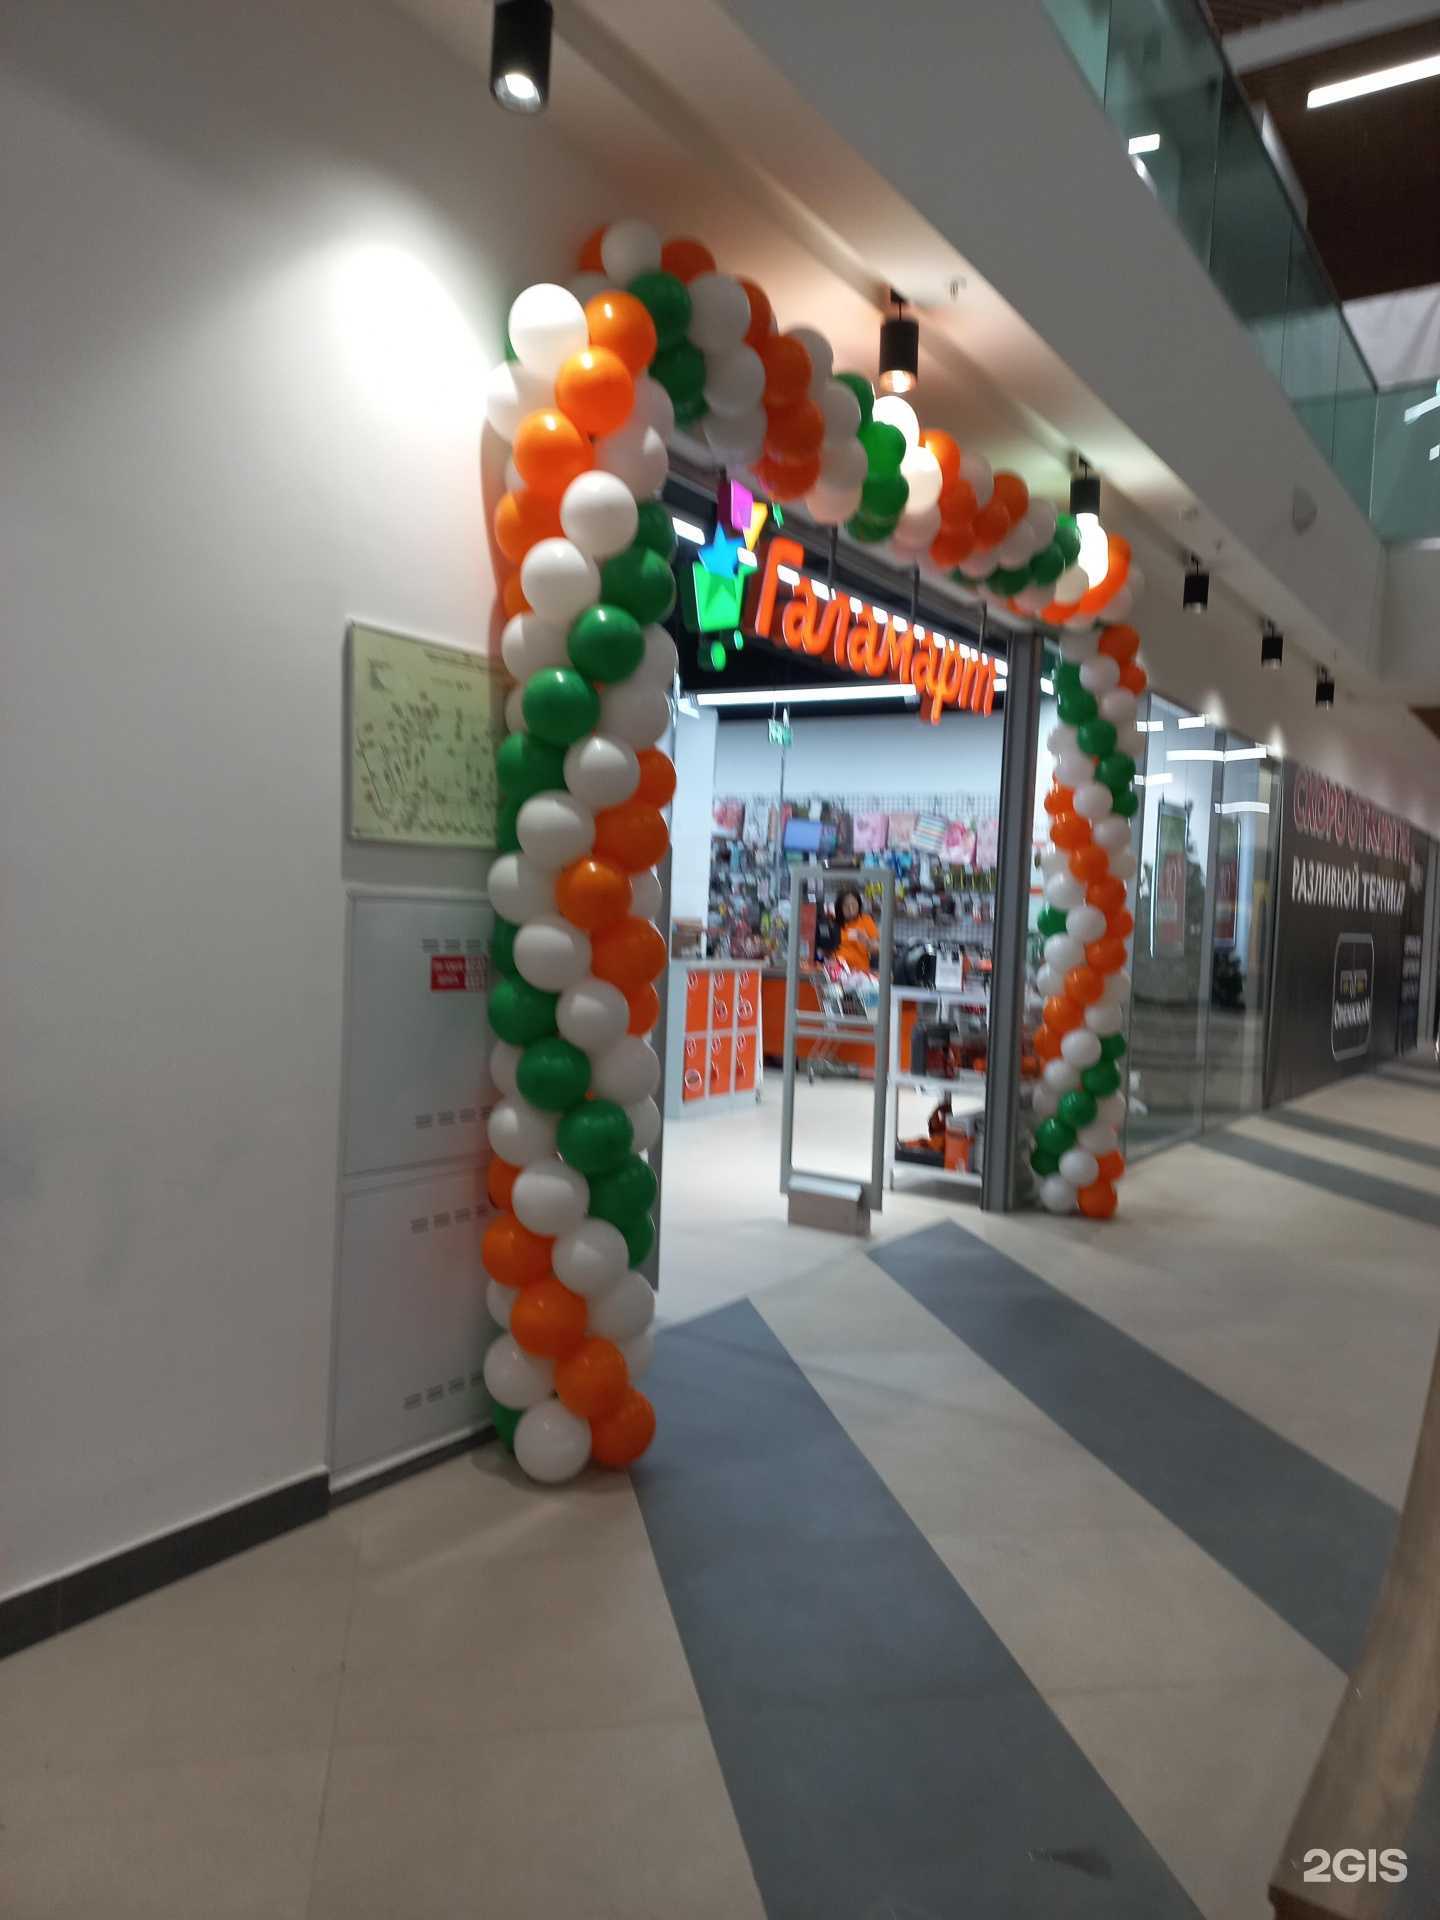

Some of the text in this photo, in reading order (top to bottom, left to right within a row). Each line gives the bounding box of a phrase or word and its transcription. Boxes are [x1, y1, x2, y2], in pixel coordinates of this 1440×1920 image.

[755, 537, 996, 725] Галамарт
[1294, 769, 1347, 846] СКОРО
[1292, 856, 1359, 912] РАЗЛИВНОЙ
